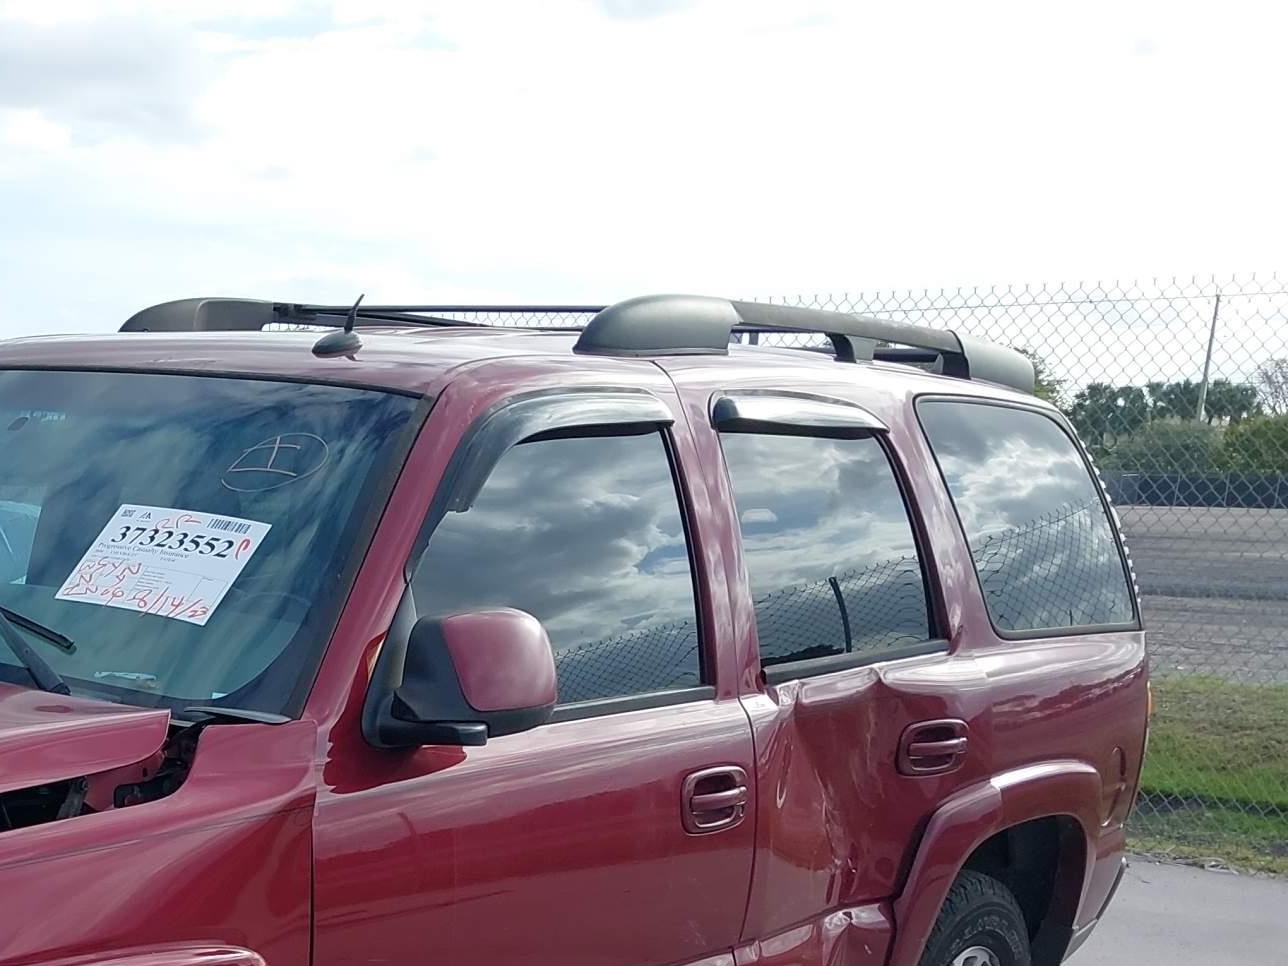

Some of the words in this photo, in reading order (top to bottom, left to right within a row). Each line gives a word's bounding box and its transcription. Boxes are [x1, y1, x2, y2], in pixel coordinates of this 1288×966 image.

[98, 542, 131, 551] Progressive
[159, 549, 190, 559] Insurance
[111, 525, 235, 558] 37323552
